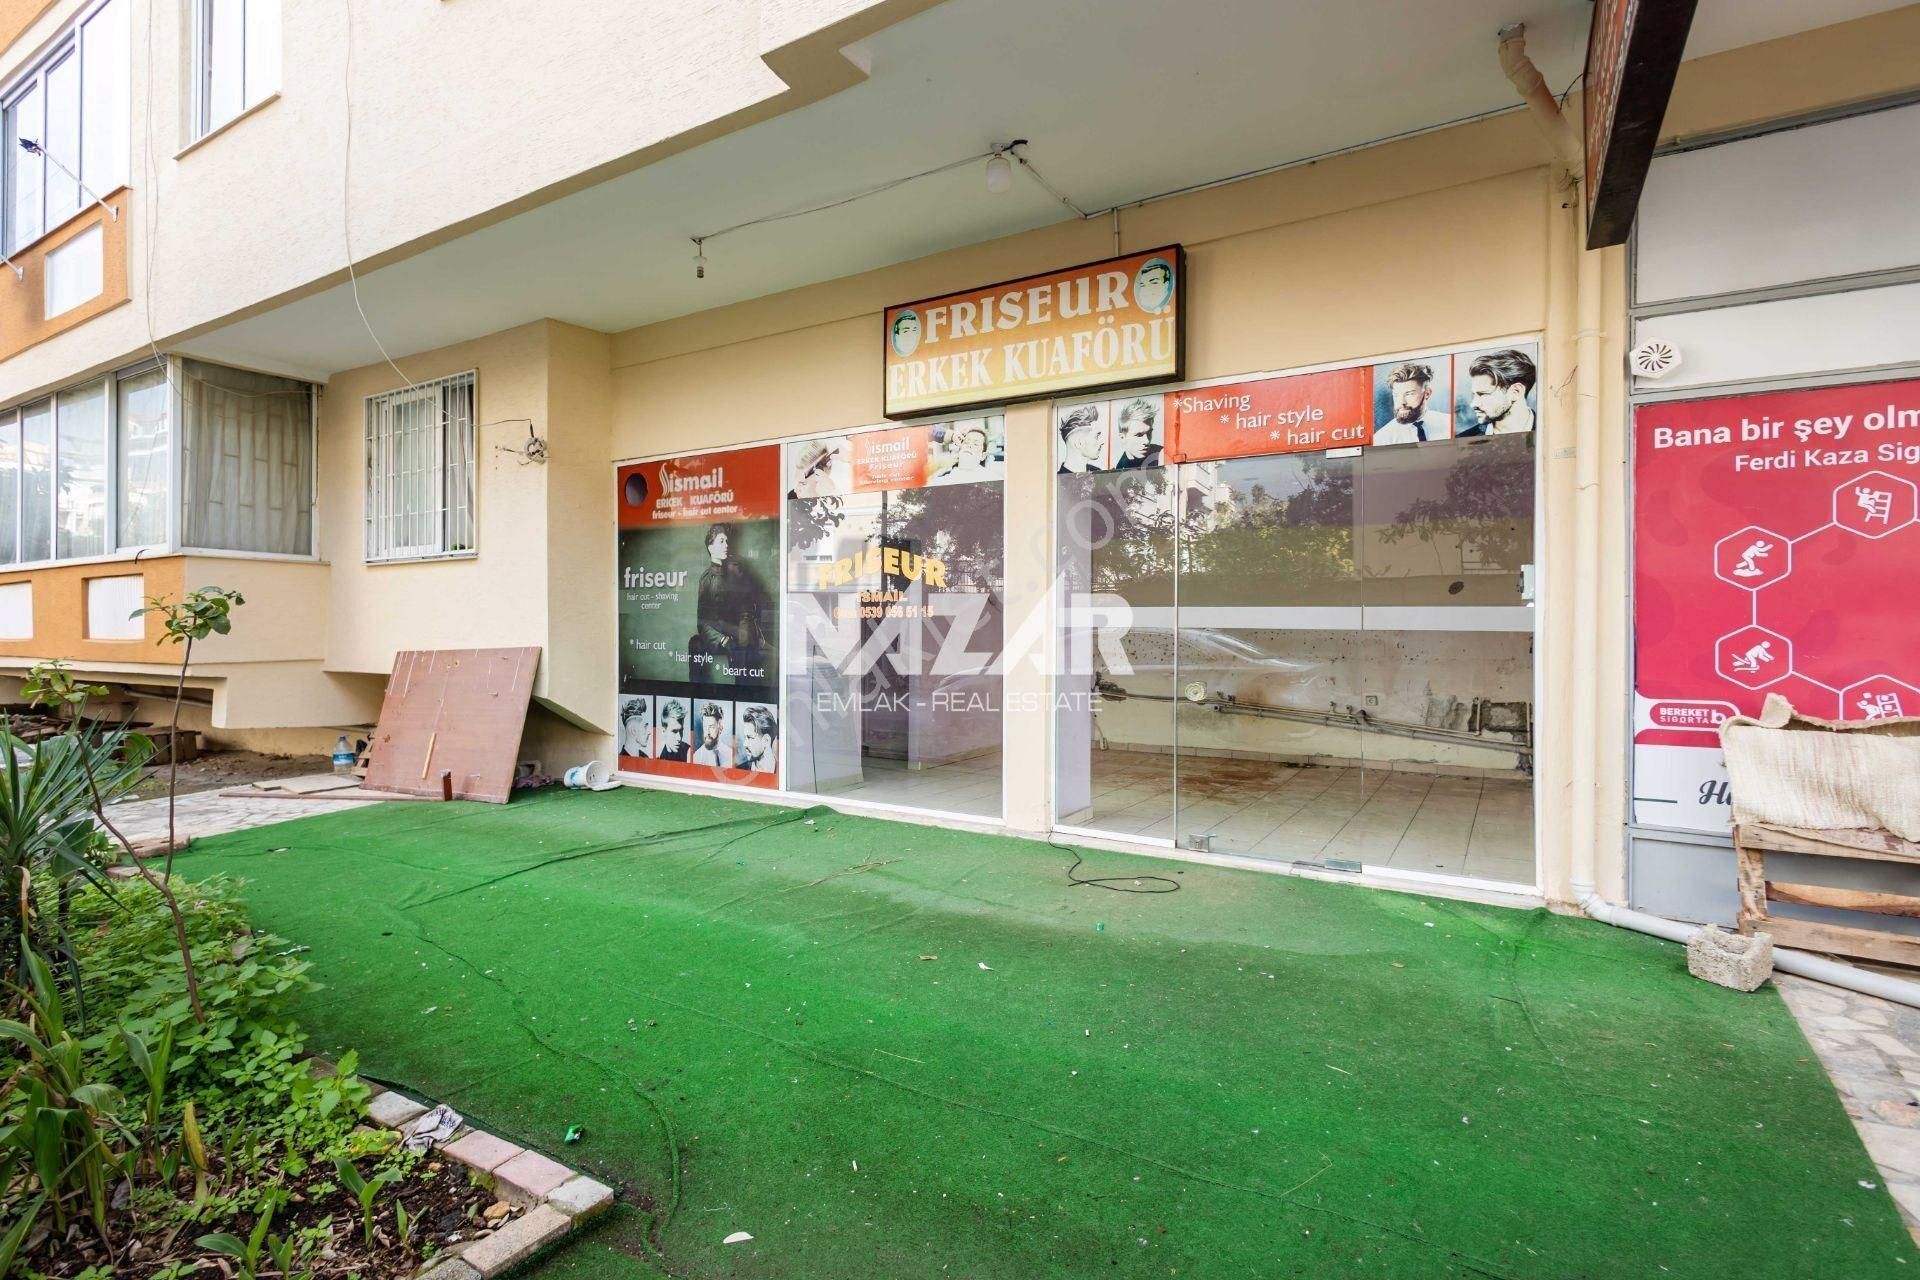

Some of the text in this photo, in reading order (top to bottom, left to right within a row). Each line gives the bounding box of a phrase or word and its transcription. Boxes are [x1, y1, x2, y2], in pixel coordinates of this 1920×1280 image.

[925, 271, 1129, 344] FRISEUR
[889, 305, 1176, 400] ERKEK KUAFÖRÜ
[1236, 405, 1323, 429] hair style
[1287, 424, 1365, 445] hair cut
[1654, 426, 1731, 449] Bana
[1741, 417, 1784, 442] bir
[1794, 414, 1853, 443] şey
[1735, 451, 1796, 472] Ferdi
[1804, 449, 1869, 468] Kaza
[656, 489, 734, 509] ERKEK KUAFÖRÜ
[652, 509, 676, 520] friseur
[713, 504, 738, 515] center
[624, 566, 688, 589] friseur
[815, 546, 947, 590] FRISEUR
[627, 592, 639, 601] hair
[655, 591, 679, 602] shaving
[641, 602, 662, 610] center
[636, 639, 666, 650] hair cut
[675, 652, 713, 666] hair style
[723, 665, 765, 677] beart cut
[1660, 707, 1710, 717] BEREKET
